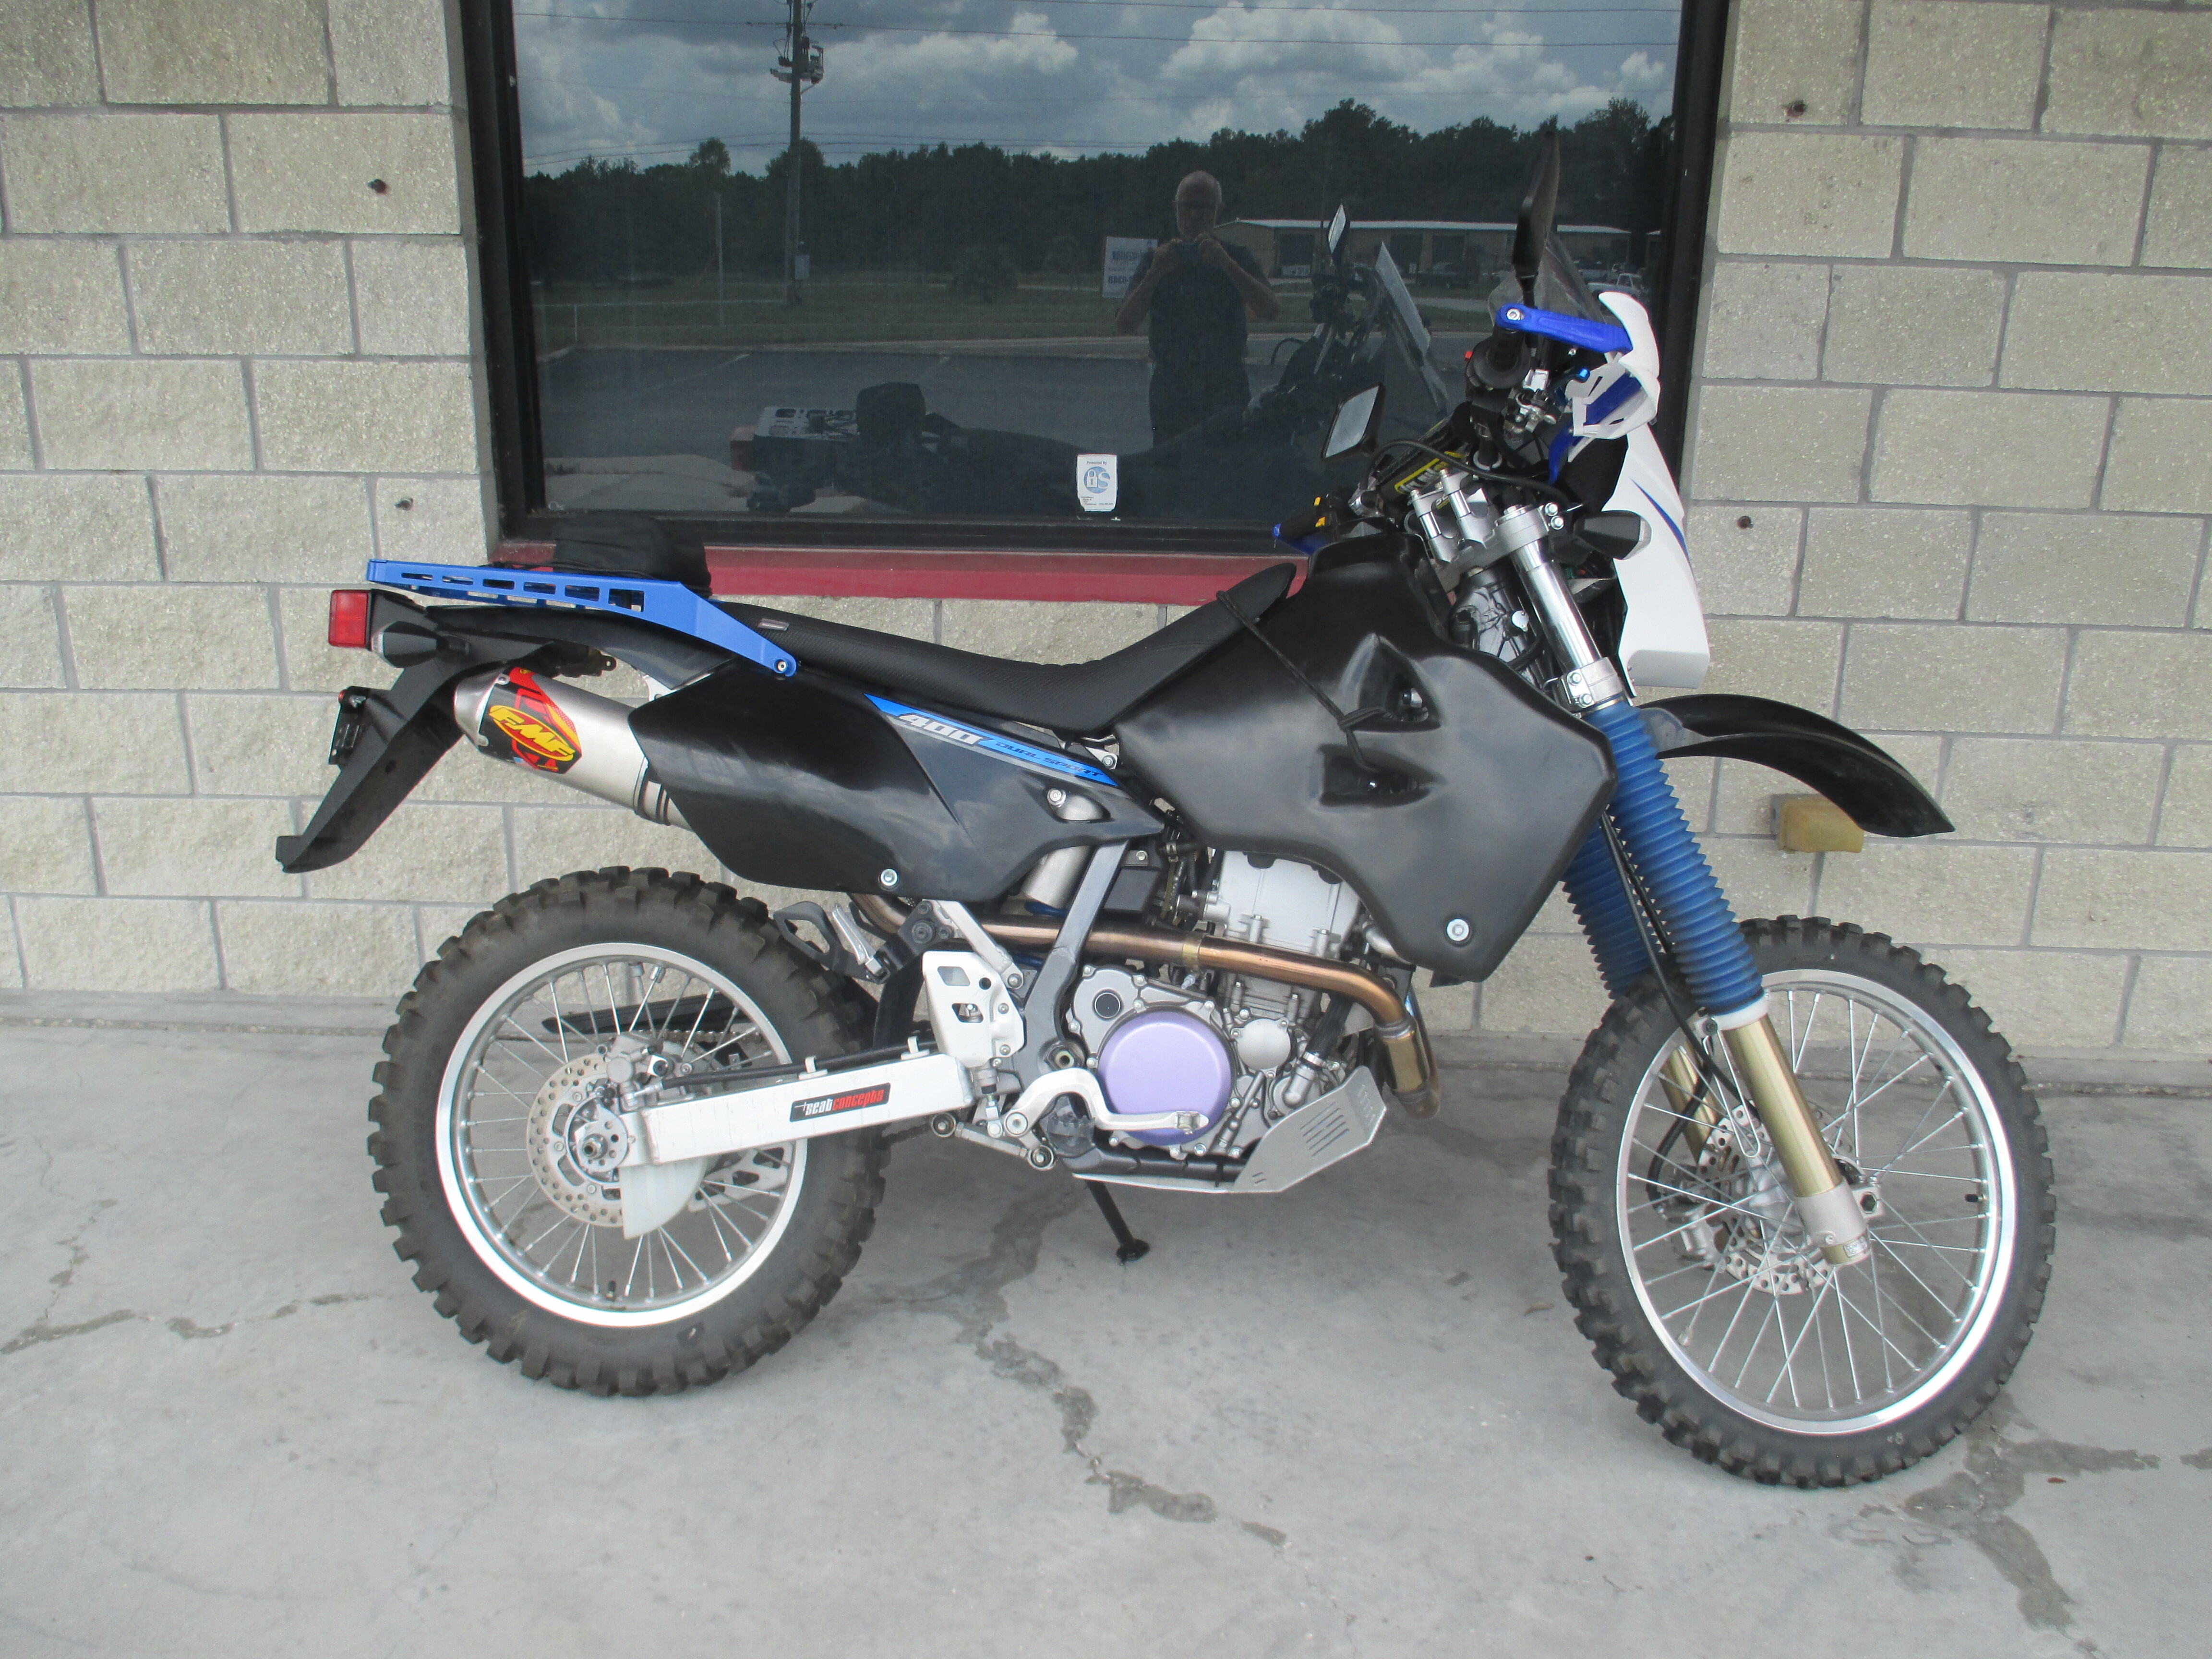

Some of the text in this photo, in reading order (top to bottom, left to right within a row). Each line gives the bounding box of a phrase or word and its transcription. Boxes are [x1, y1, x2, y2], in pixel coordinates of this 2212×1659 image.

[489, 707, 576, 757] FMF
[899, 714, 984, 745] 400
[995, 741, 1104, 777] DUAL SPORT
